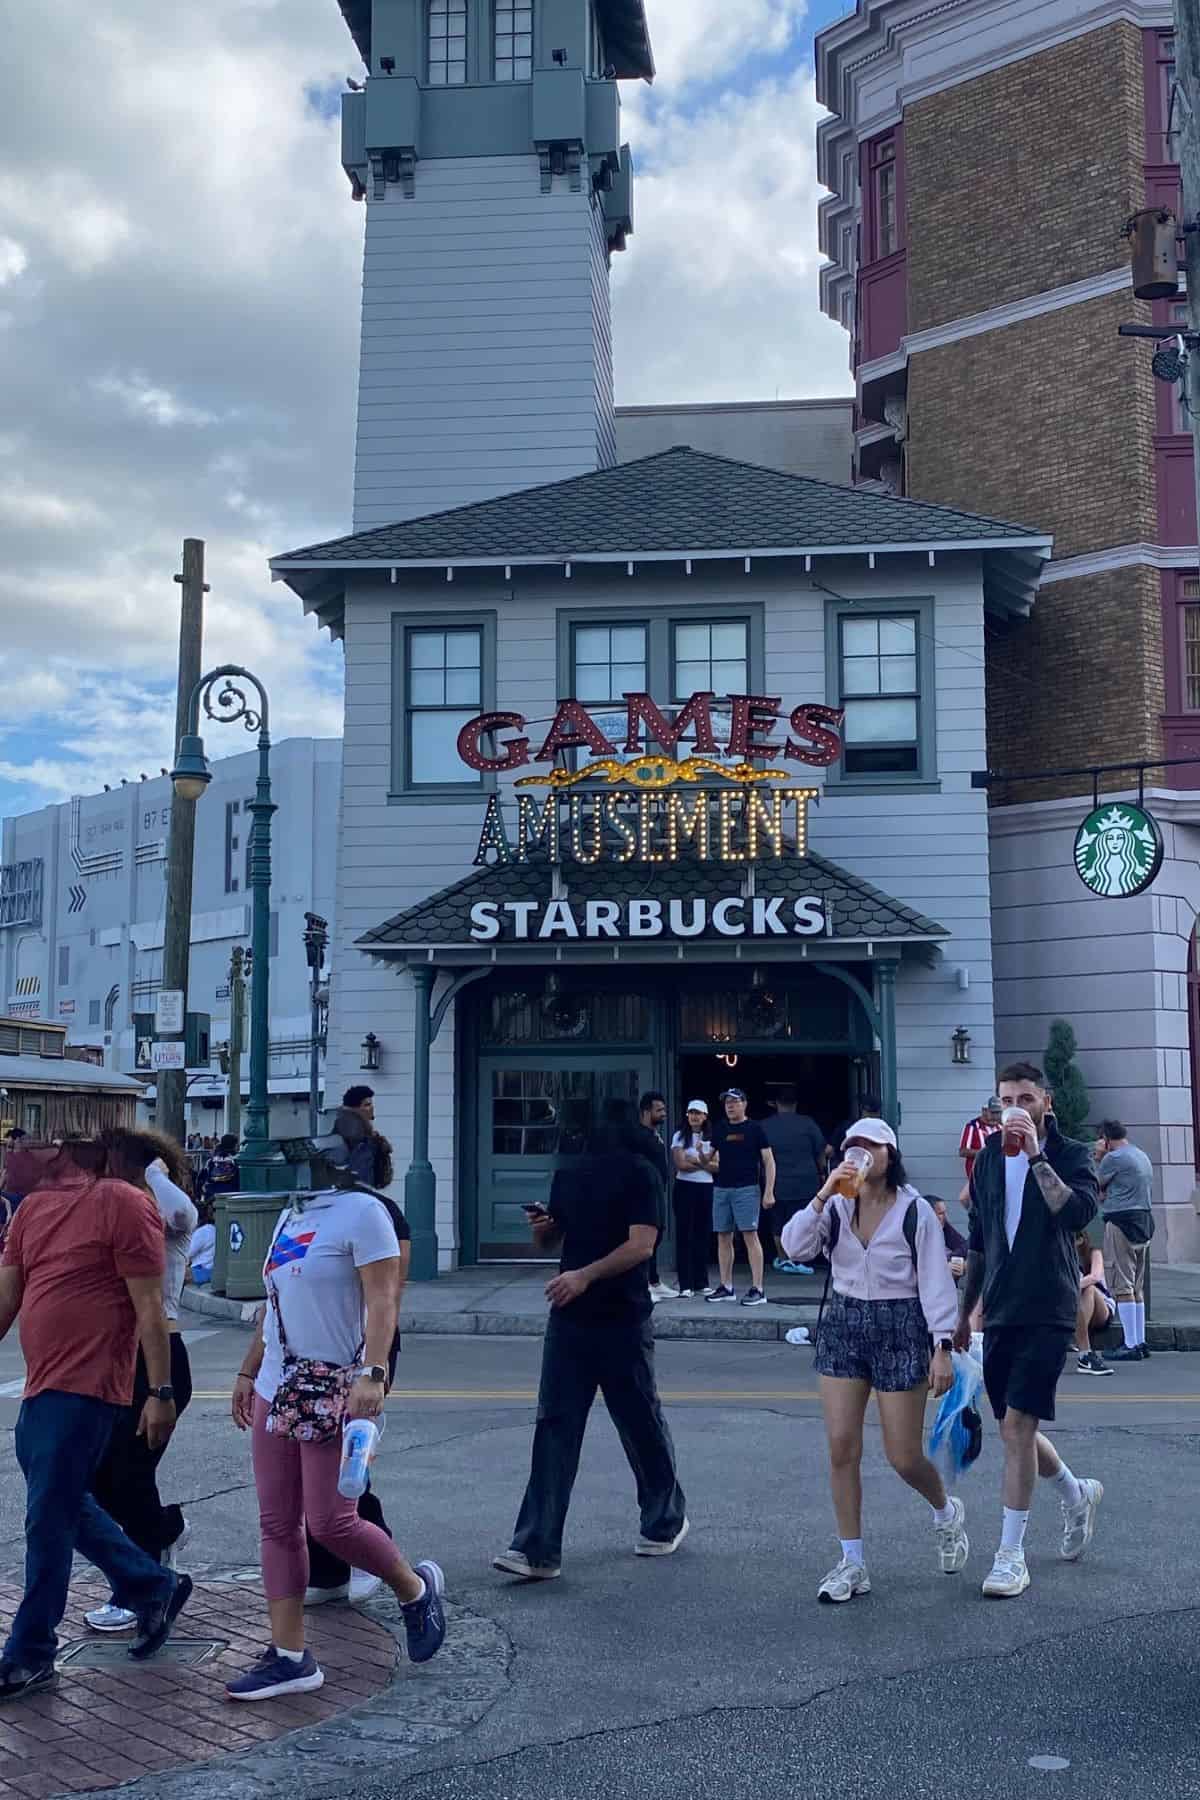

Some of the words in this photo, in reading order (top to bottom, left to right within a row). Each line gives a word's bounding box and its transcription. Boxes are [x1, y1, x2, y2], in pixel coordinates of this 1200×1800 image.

[457, 692, 845, 772] GAMES
[473, 787, 823, 866] AMUSEMENT
[469, 895, 826, 940] STARBUCKS
